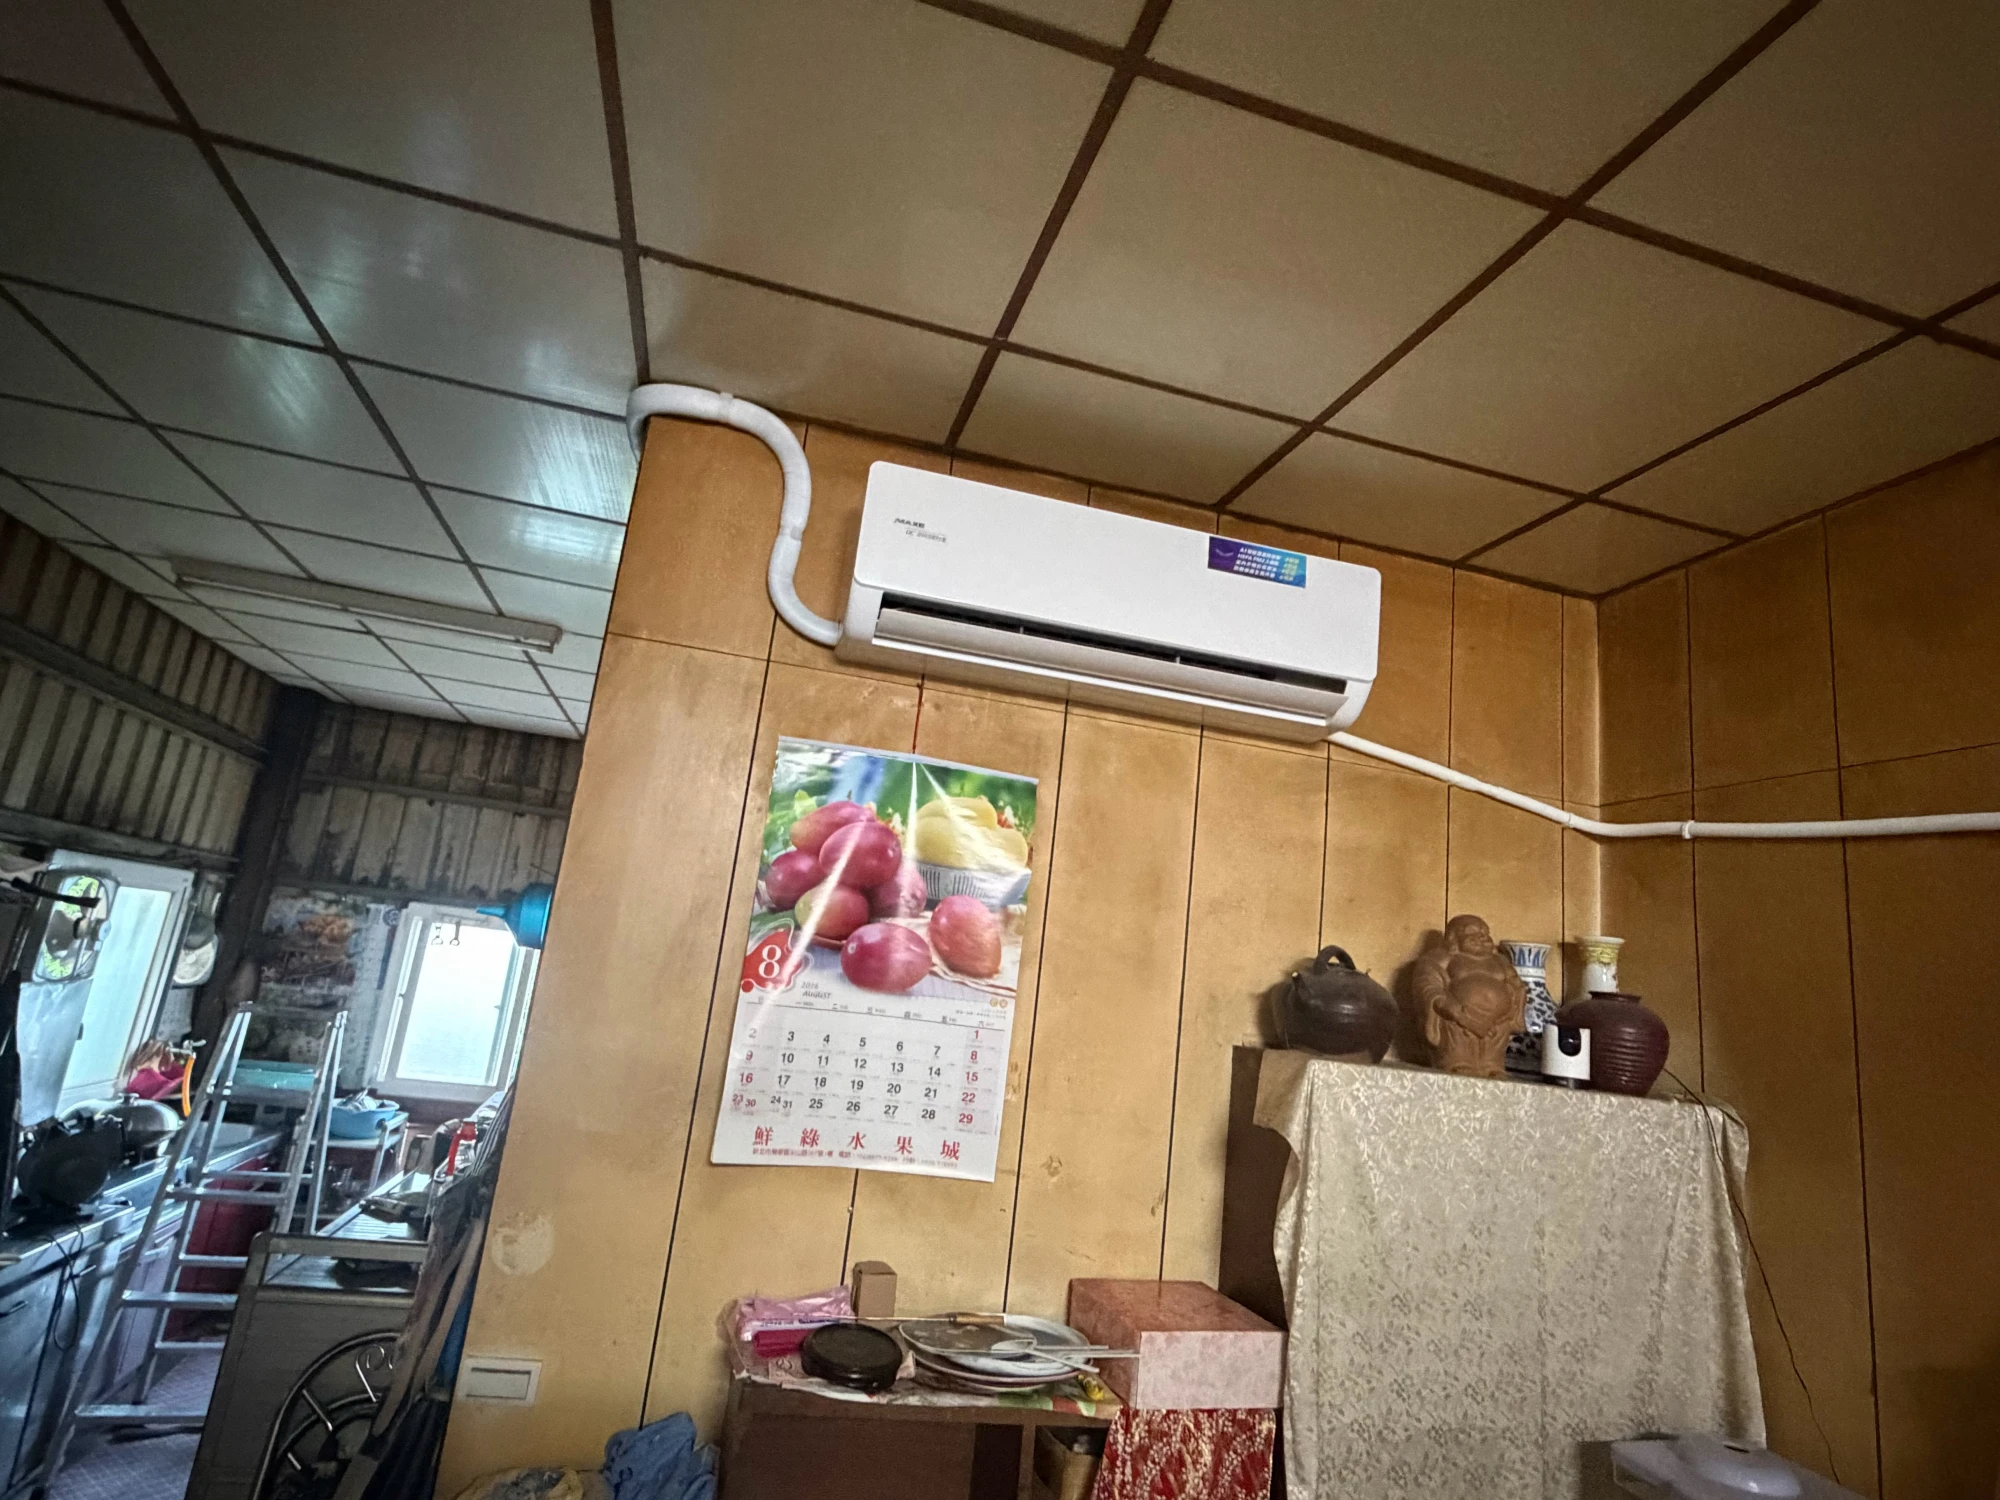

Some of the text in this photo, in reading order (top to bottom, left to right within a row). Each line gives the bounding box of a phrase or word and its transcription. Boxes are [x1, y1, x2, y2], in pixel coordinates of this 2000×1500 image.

[758, 944, 782, 978] 8
[748, 1028, 978, 1060] 2 3 4 5 6 7 8
[974, 1030, 979, 1039] 1
[746, 1050, 978, 1082] 9 10 11 12 13 14 15
[740, 1072, 976, 1102] 16 17 18 19 20 21 22
[745, 1098, 756, 1107] 30
[771, 1096, 781, 1104] 24
[782, 1100, 792, 1108] 31
[809, 1098, 824, 1108] 25
[846, 1101, 860, 1111] 26
[884, 1104, 898, 1115] 27
[921, 1108, 936, 1120] 28
[958, 1112, 973, 1124] 29
